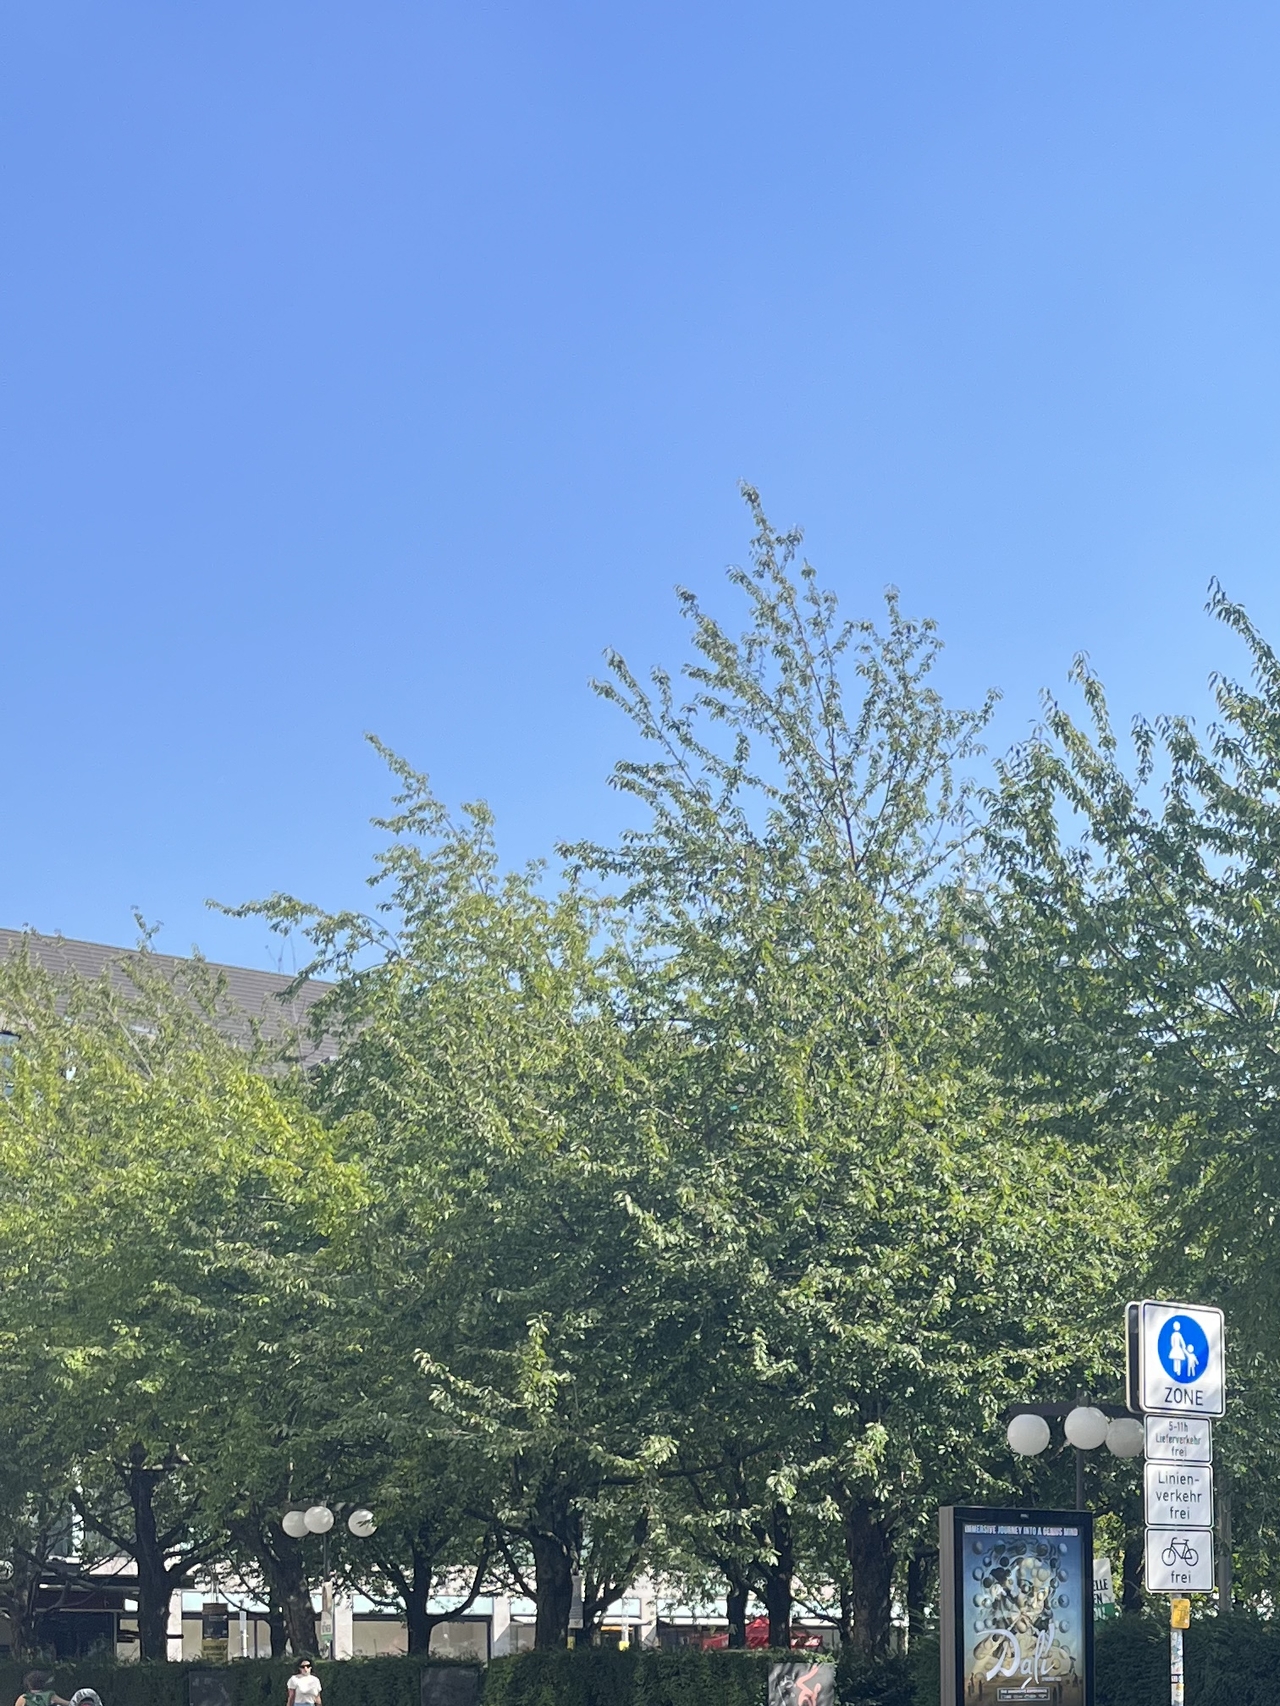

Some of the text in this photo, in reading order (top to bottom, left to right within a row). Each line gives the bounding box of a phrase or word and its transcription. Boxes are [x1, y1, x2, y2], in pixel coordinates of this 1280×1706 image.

[1164, 1387, 1204, 1407] ZONE
[1168, 1420, 1189, 1432] 5-11h
[1155, 1433, 1201, 1445] Lieferverkehr
[1171, 1446, 1187, 1457] frei
[1157, 1470, 1200, 1487] Linien-
[1155, 1486, 1202, 1503] verkehr
[1169, 1507, 1191, 1520] frei
[998, 1526, 1022, 1535] JOURNEY
[1023, 1526, 1036, 1535] INTO
[1037, 1527, 1042, 1536] A
[1170, 1570, 1192, 1584] frei
